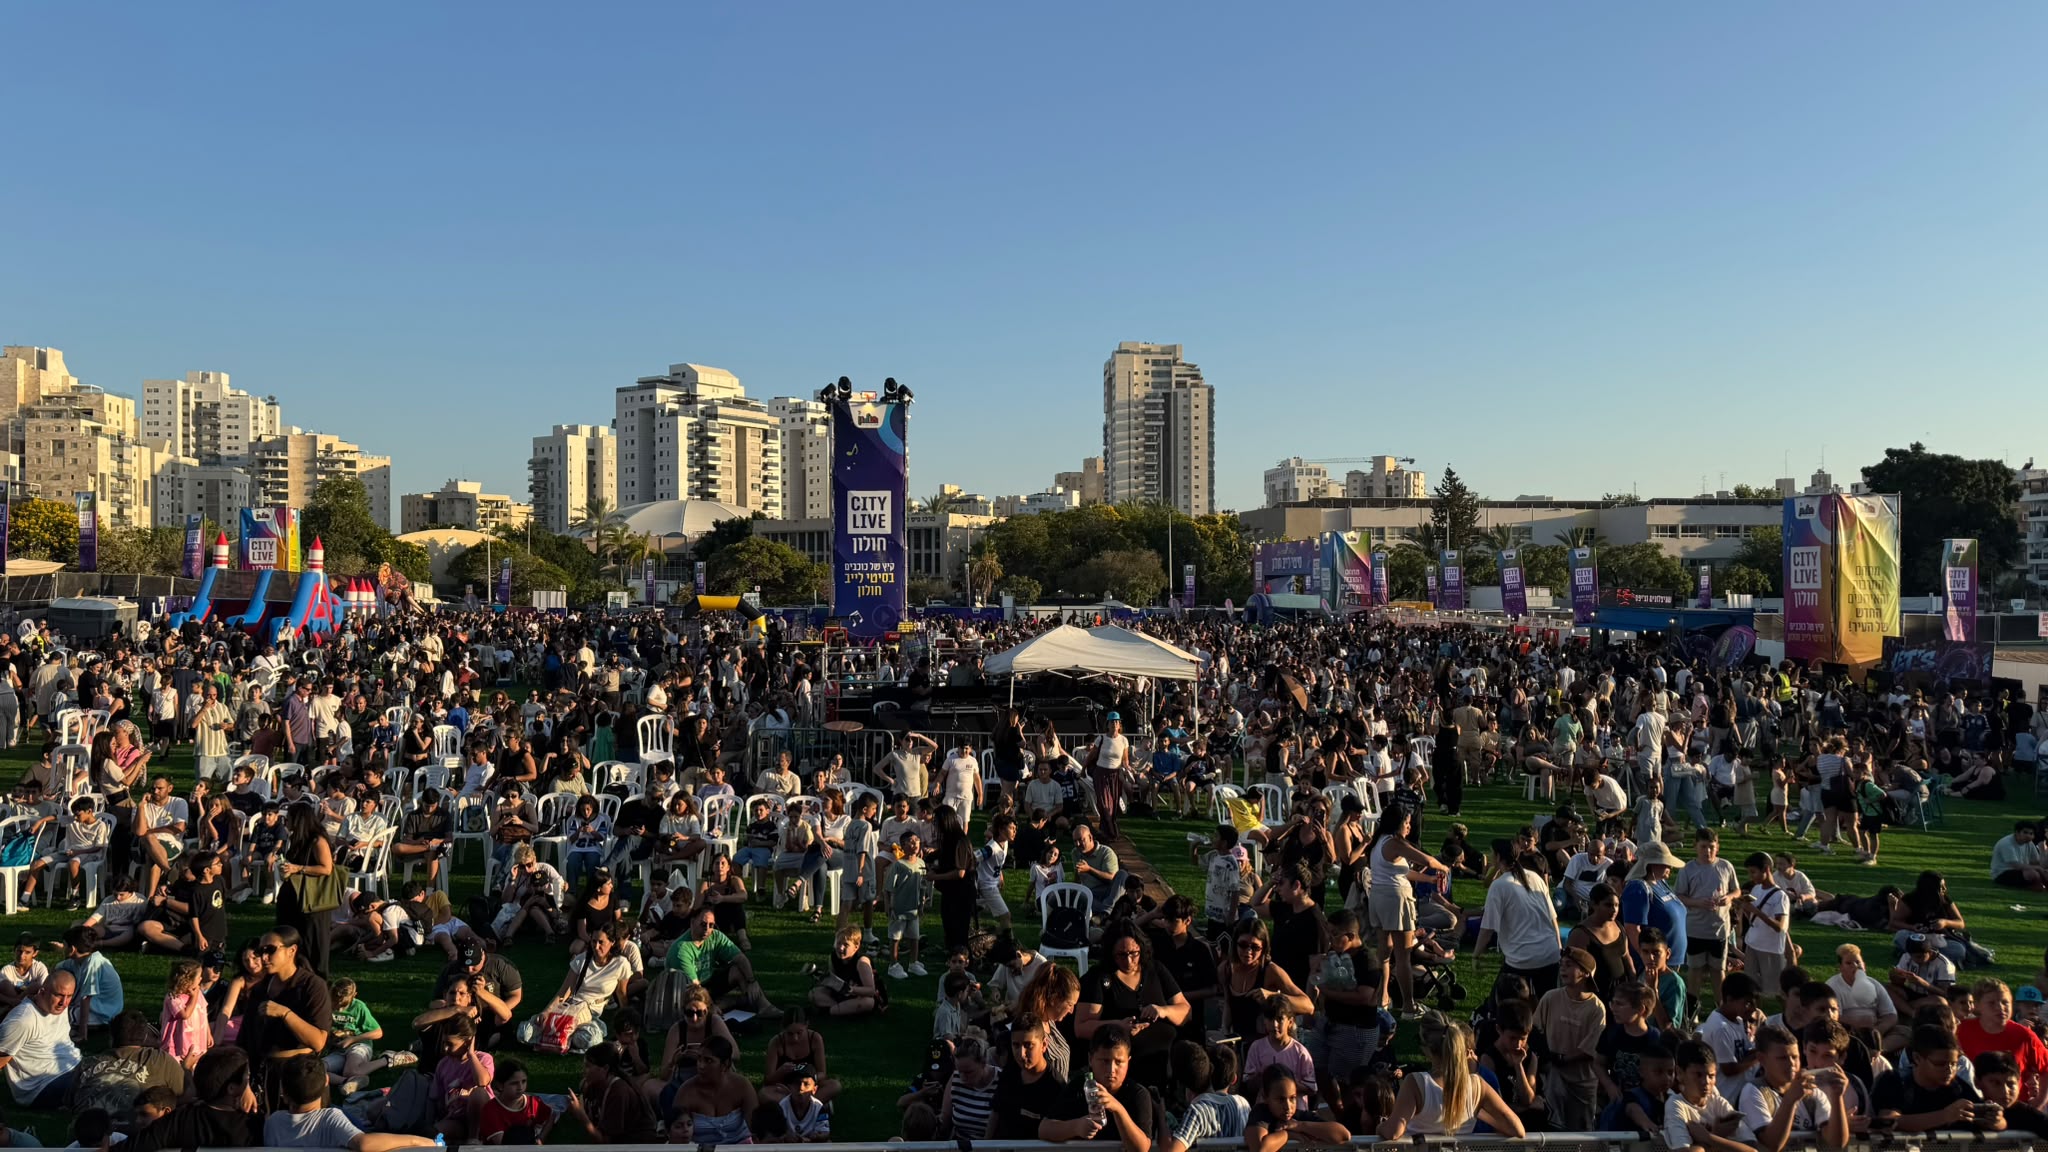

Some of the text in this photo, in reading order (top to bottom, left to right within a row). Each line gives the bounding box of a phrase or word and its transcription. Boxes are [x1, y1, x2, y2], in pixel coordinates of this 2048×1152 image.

[850, 496, 887, 511] CITY
[852, 514, 886, 529] LIVE
[251, 540, 274, 550] CITY
[852, 536, 887, 554] חולון
[252, 551, 274, 561] LIVE
[1793, 551, 1817, 566] CITY
[844, 561, 895, 572] קיץ של כוכבים
[844, 571, 895, 584] בסיטי לייב
[1794, 569, 1818, 584] LIVE
[857, 584, 882, 598] חולון
[1794, 590, 1818, 608] חולון
[1855, 607, 1882, 618] החדש
[1848, 621, 1889, 633] של העיר!
